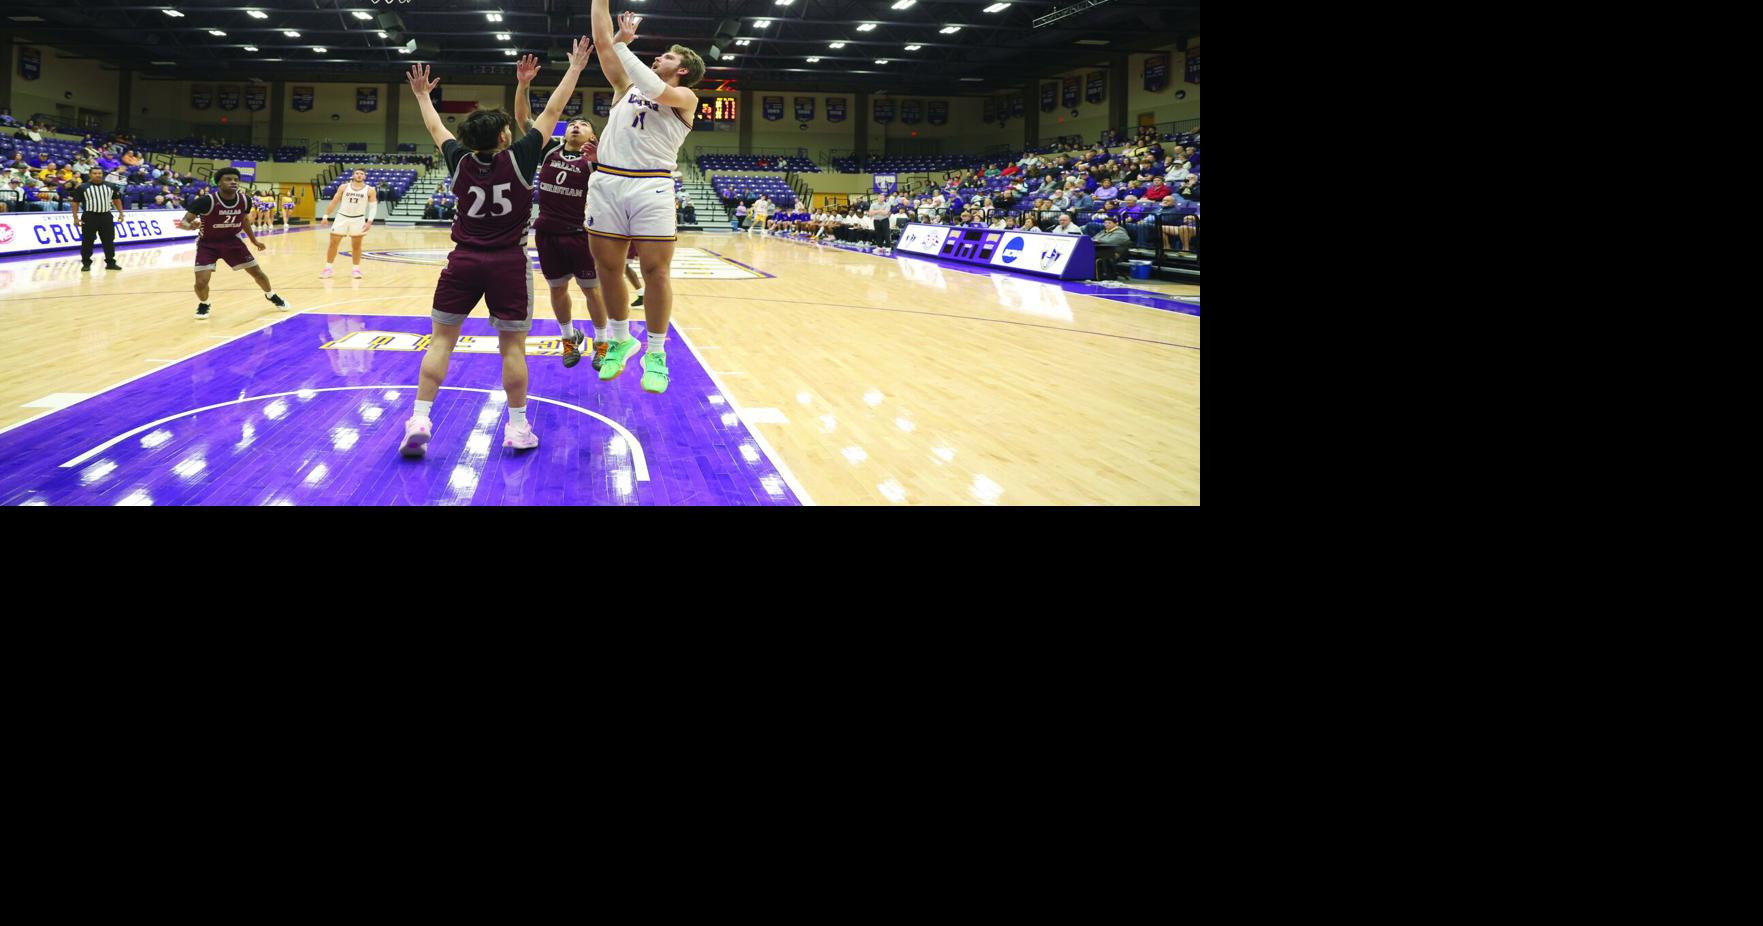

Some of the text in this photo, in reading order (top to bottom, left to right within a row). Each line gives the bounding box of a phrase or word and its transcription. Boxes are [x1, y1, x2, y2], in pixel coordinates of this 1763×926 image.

[556, 171, 567, 185] 0
[540, 182, 583, 197] CHRISTIAN
[467, 182, 513, 218] 25
[224, 215, 237, 223] 21
[33, 220, 162, 245] CRUDERS
